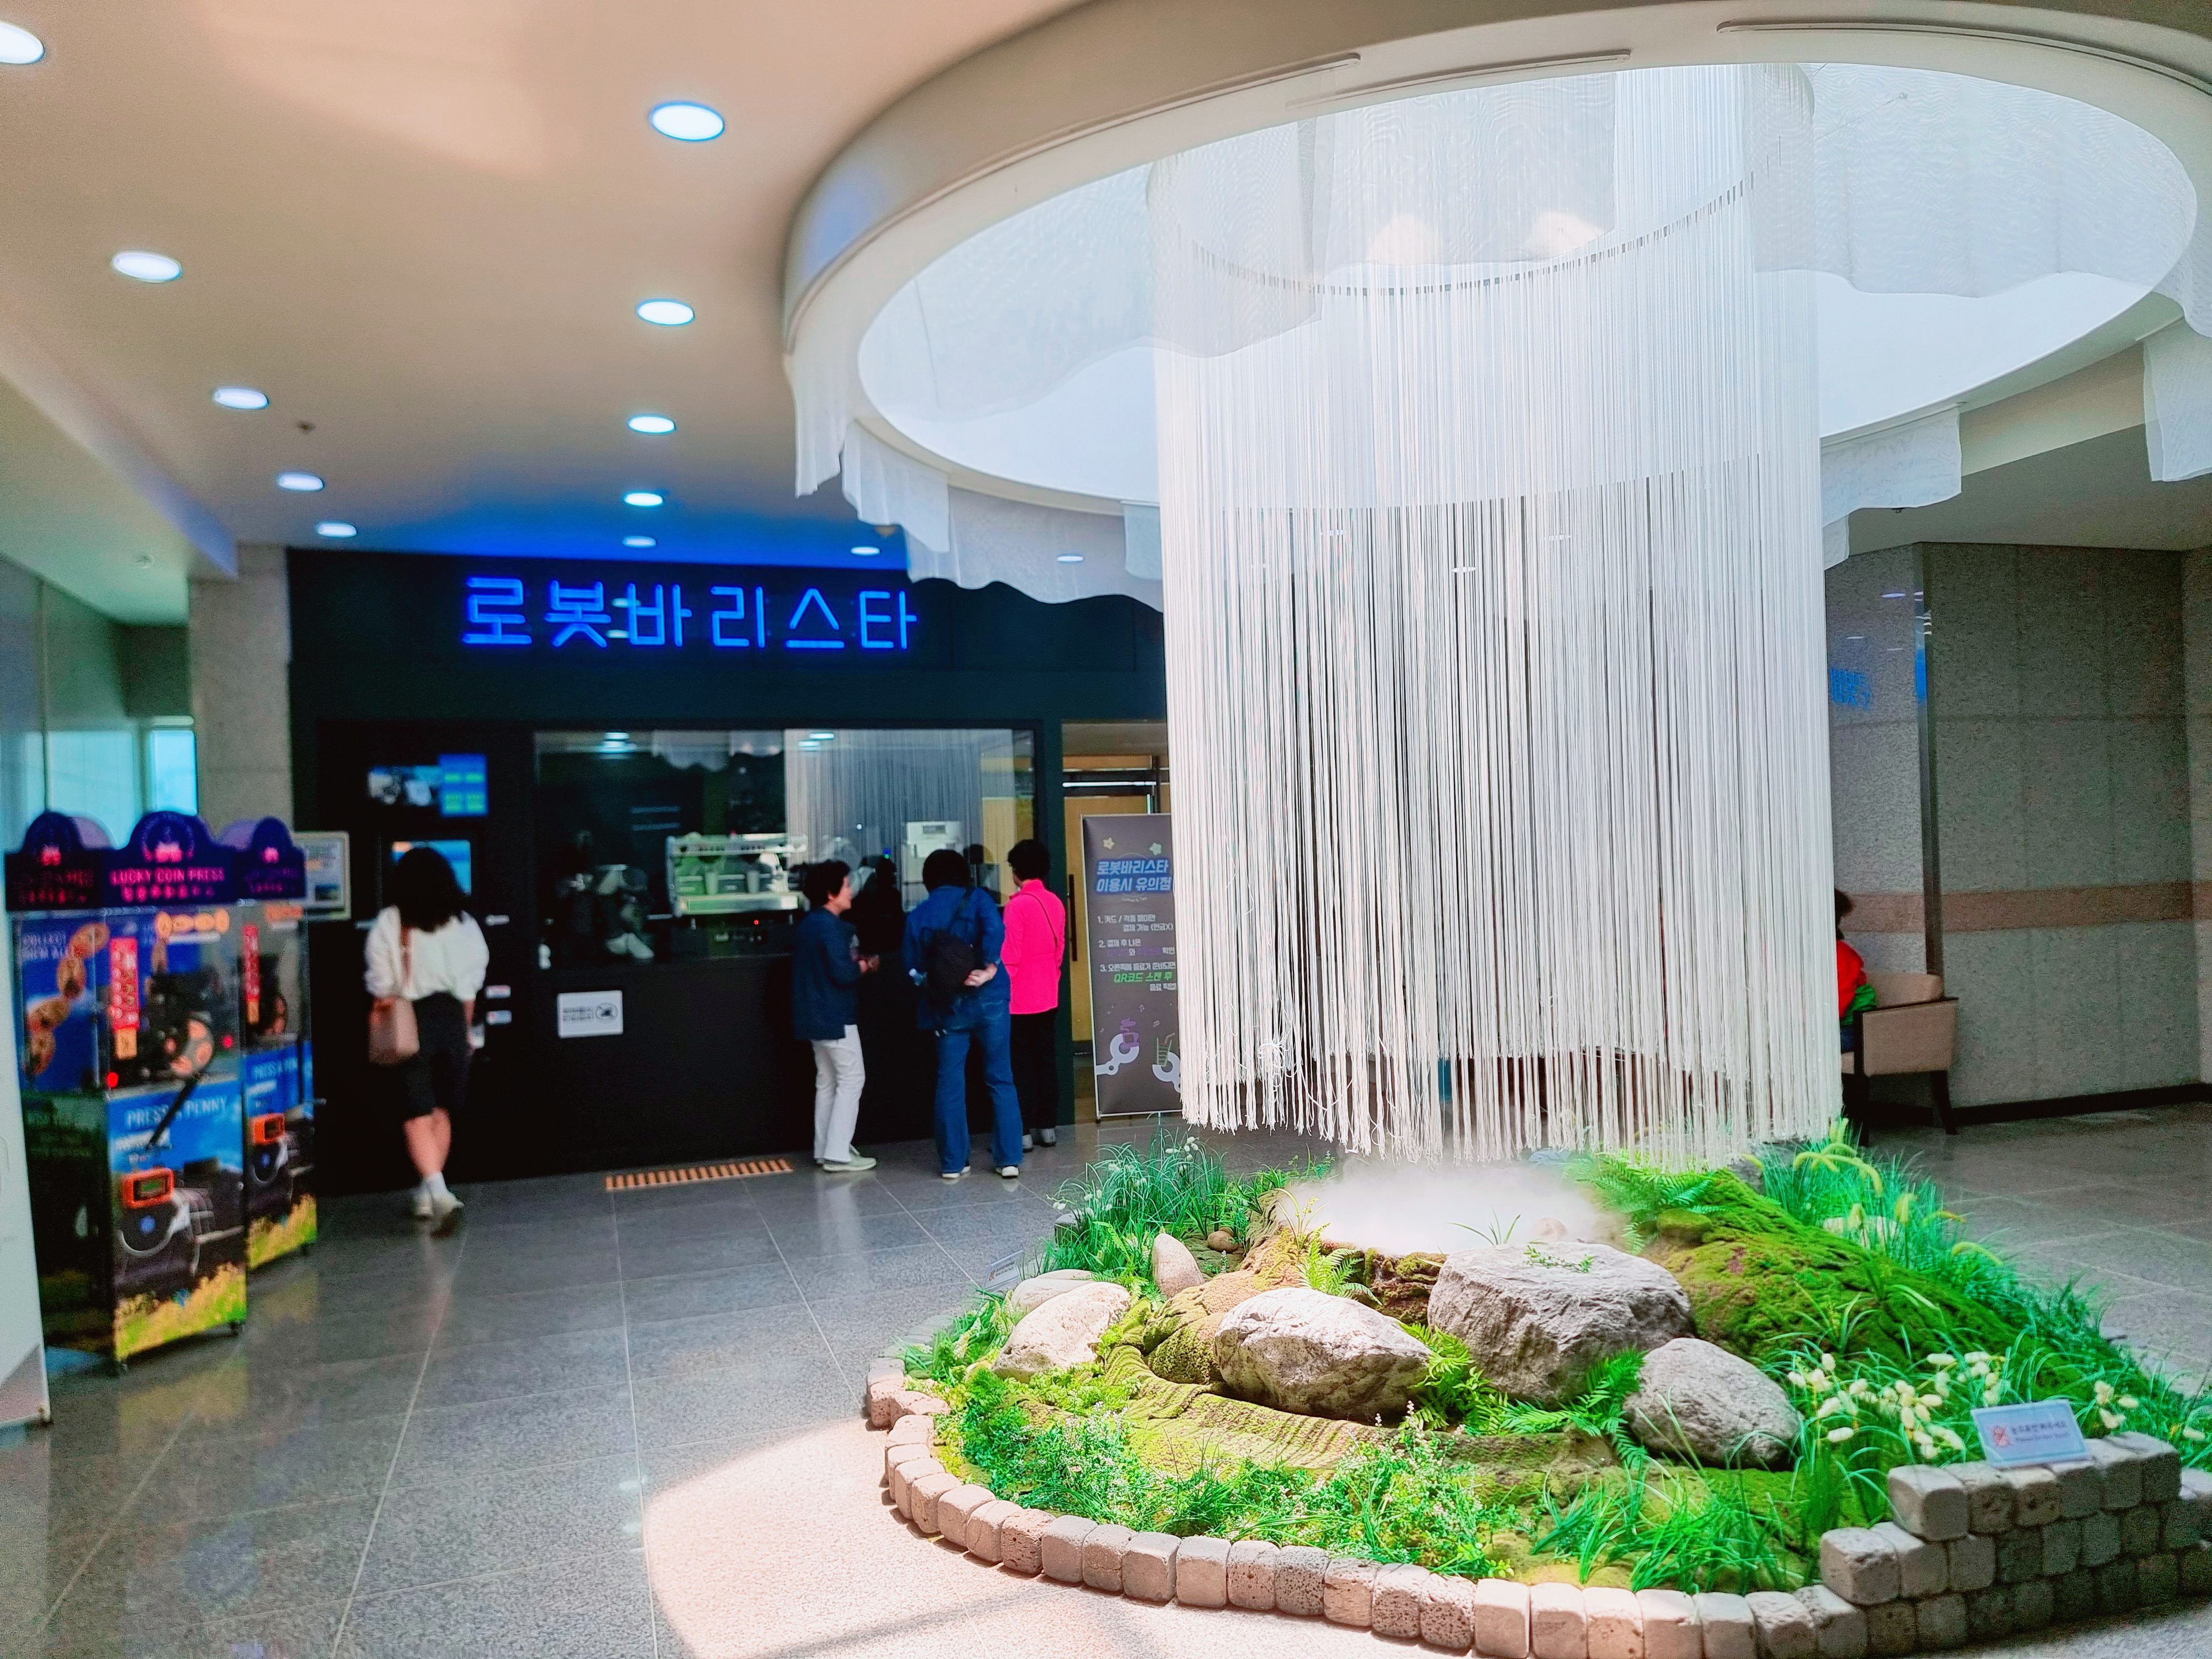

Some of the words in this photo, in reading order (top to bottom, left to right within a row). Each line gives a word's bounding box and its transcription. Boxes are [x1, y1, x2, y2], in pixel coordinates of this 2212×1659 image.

[462, 576, 918, 649] 로봇바리스타
[1097, 859, 1168, 875] 로봇바리스타
[112, 868, 151, 885] LUCKY
[155, 867, 185, 883] COIN
[1096, 878, 1133, 892] 이용시
[1135, 877, 1172, 891] 유의점
[1114, 972, 1144, 983] QR코드
